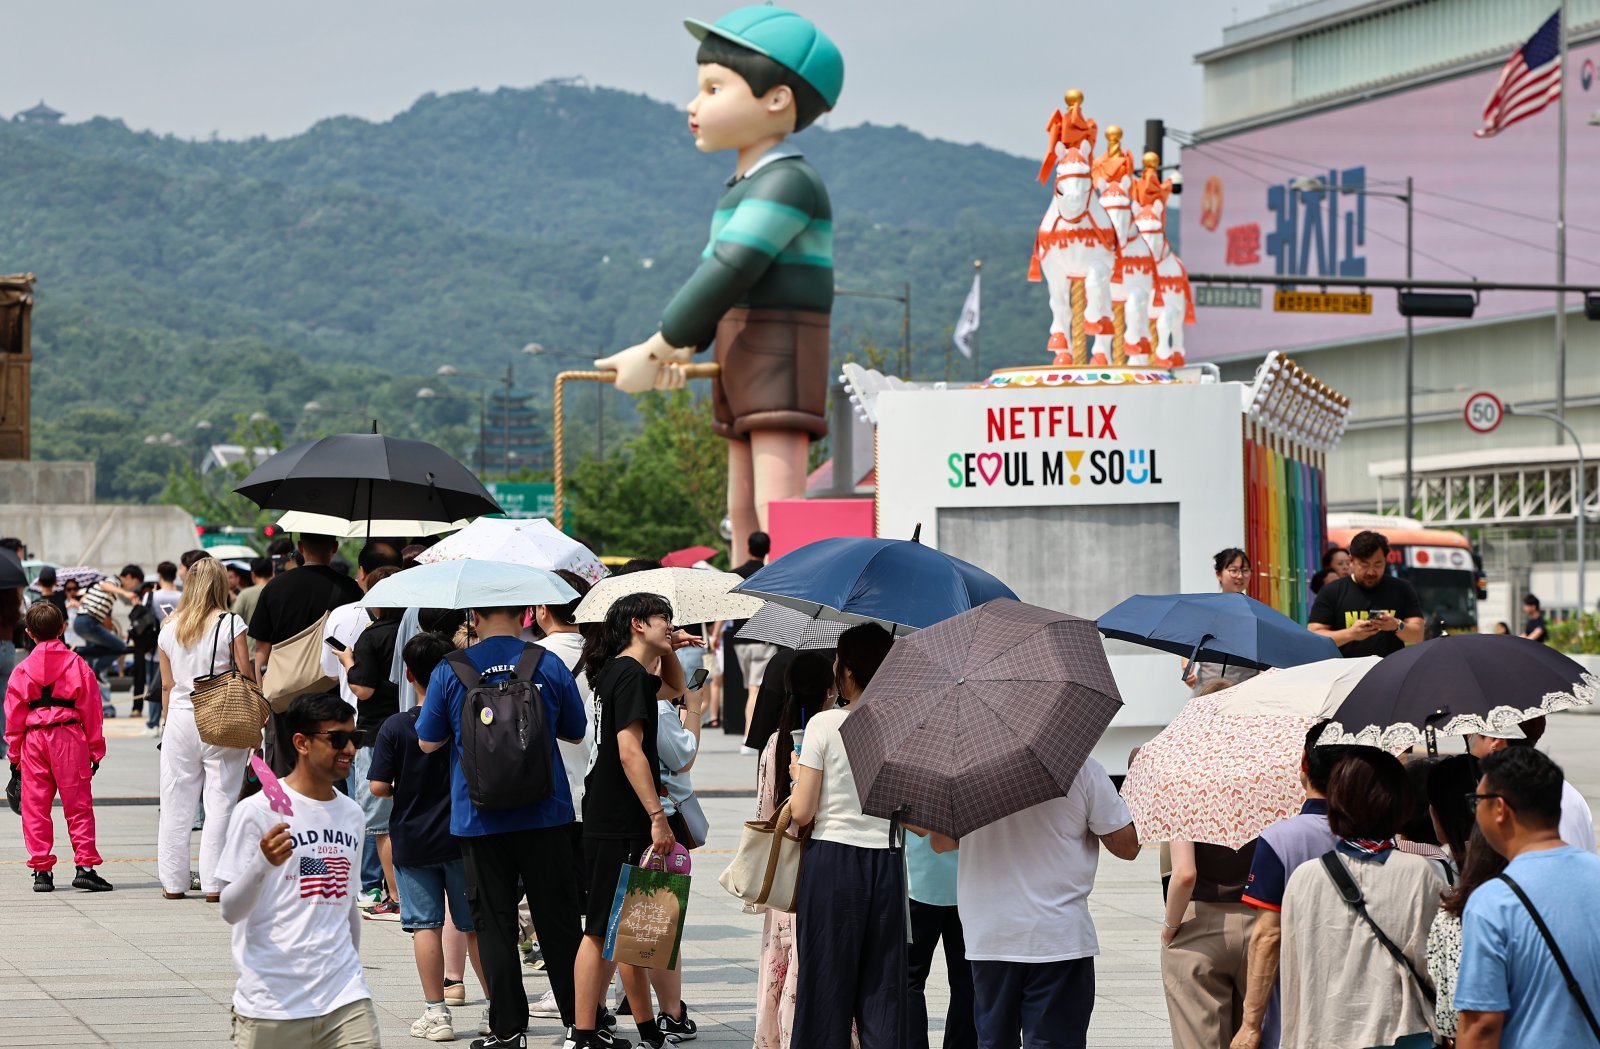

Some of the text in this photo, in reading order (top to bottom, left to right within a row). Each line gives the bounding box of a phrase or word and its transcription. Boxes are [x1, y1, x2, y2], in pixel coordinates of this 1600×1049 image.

[1472, 402, 1495, 423] 50
[987, 405, 1118, 443] NETFLIX
[947, 451, 1035, 488] SEOUL
[1090, 449, 1163, 485] SOUL
[289, 829, 358, 851] OLD NAVY
[317, 846, 338, 854] 2025
